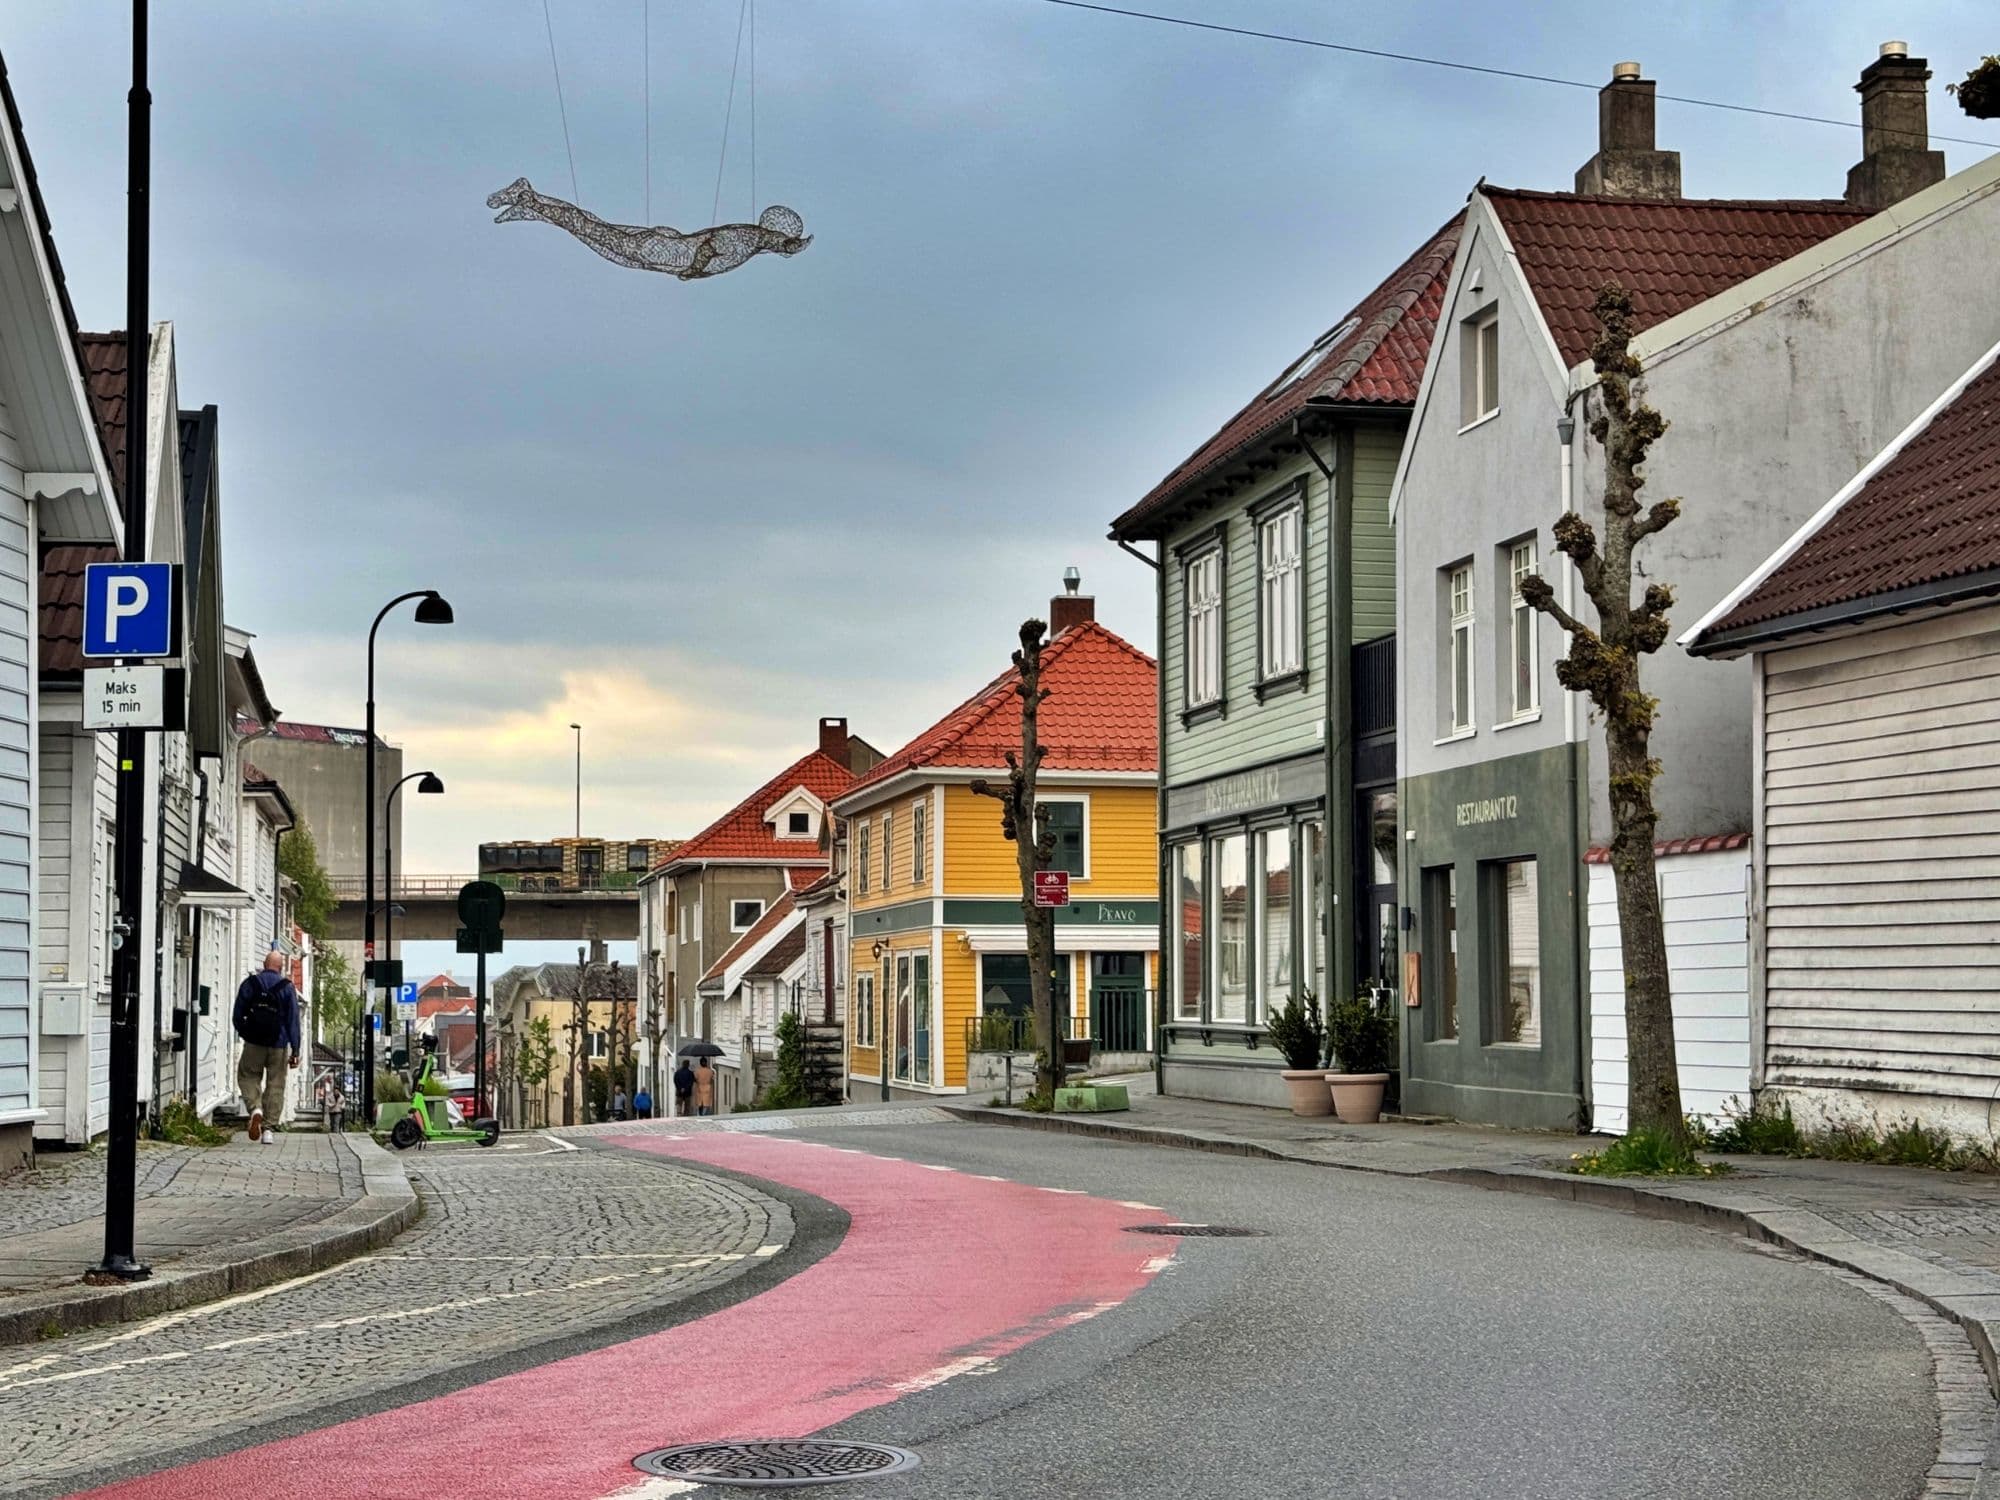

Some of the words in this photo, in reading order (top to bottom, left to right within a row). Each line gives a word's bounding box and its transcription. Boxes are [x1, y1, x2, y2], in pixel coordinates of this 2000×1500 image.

[105, 576, 149, 643] P
[105, 681, 137, 695] Maks
[102, 700, 114, 714] 15
[119, 700, 141, 713] min
[1456, 797, 1505, 827] RESTAURANT
[1506, 795, 1517, 818] K2
[401, 984, 412, 1001] P
